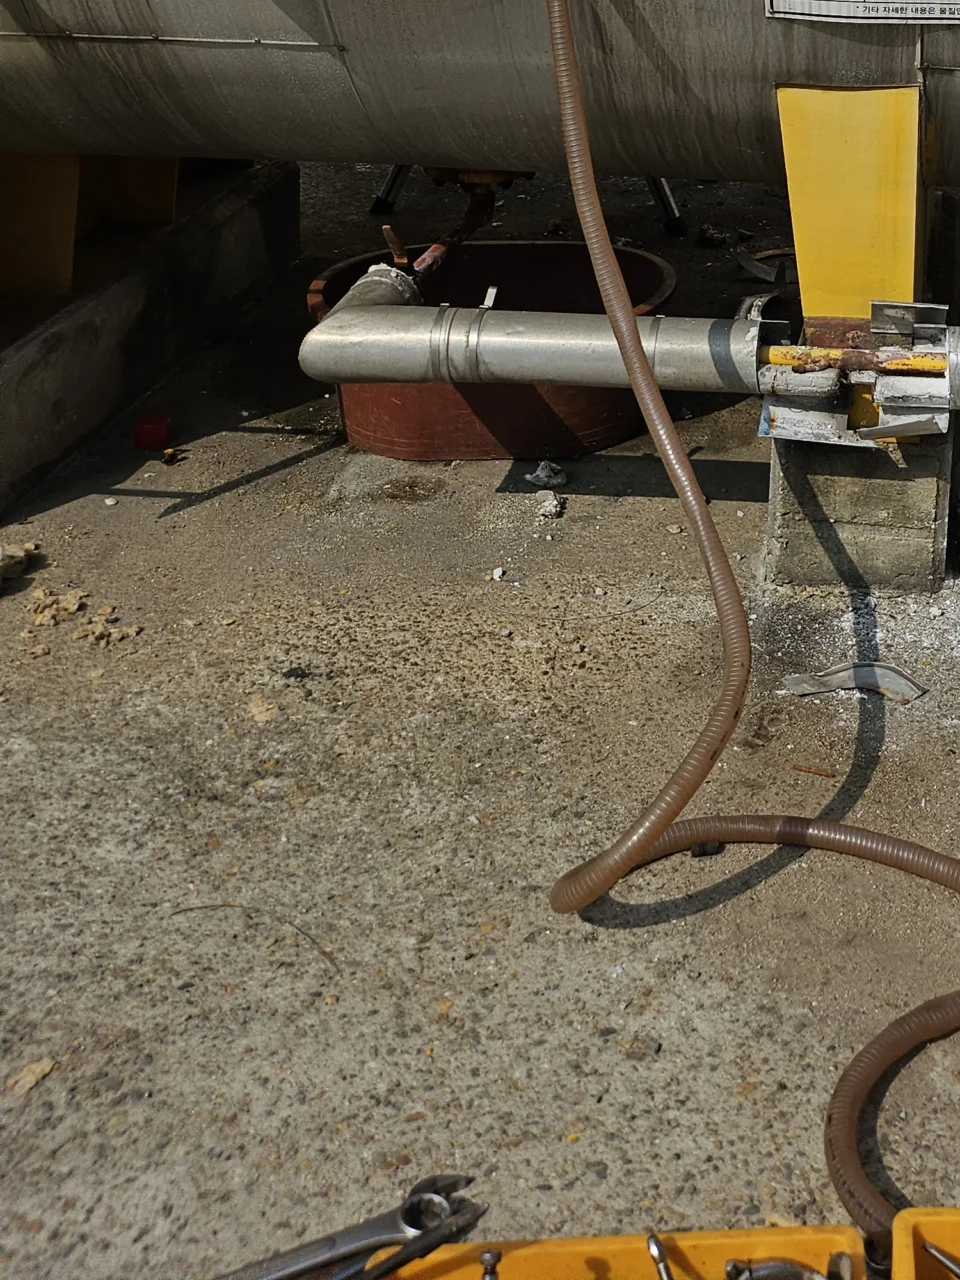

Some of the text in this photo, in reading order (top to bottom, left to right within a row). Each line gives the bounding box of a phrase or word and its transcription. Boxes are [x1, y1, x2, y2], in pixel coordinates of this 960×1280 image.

[862, 5, 880, 14] 기타
[882, 6, 908, 15] 자세한
[910, 6, 936, 15] 내용은
